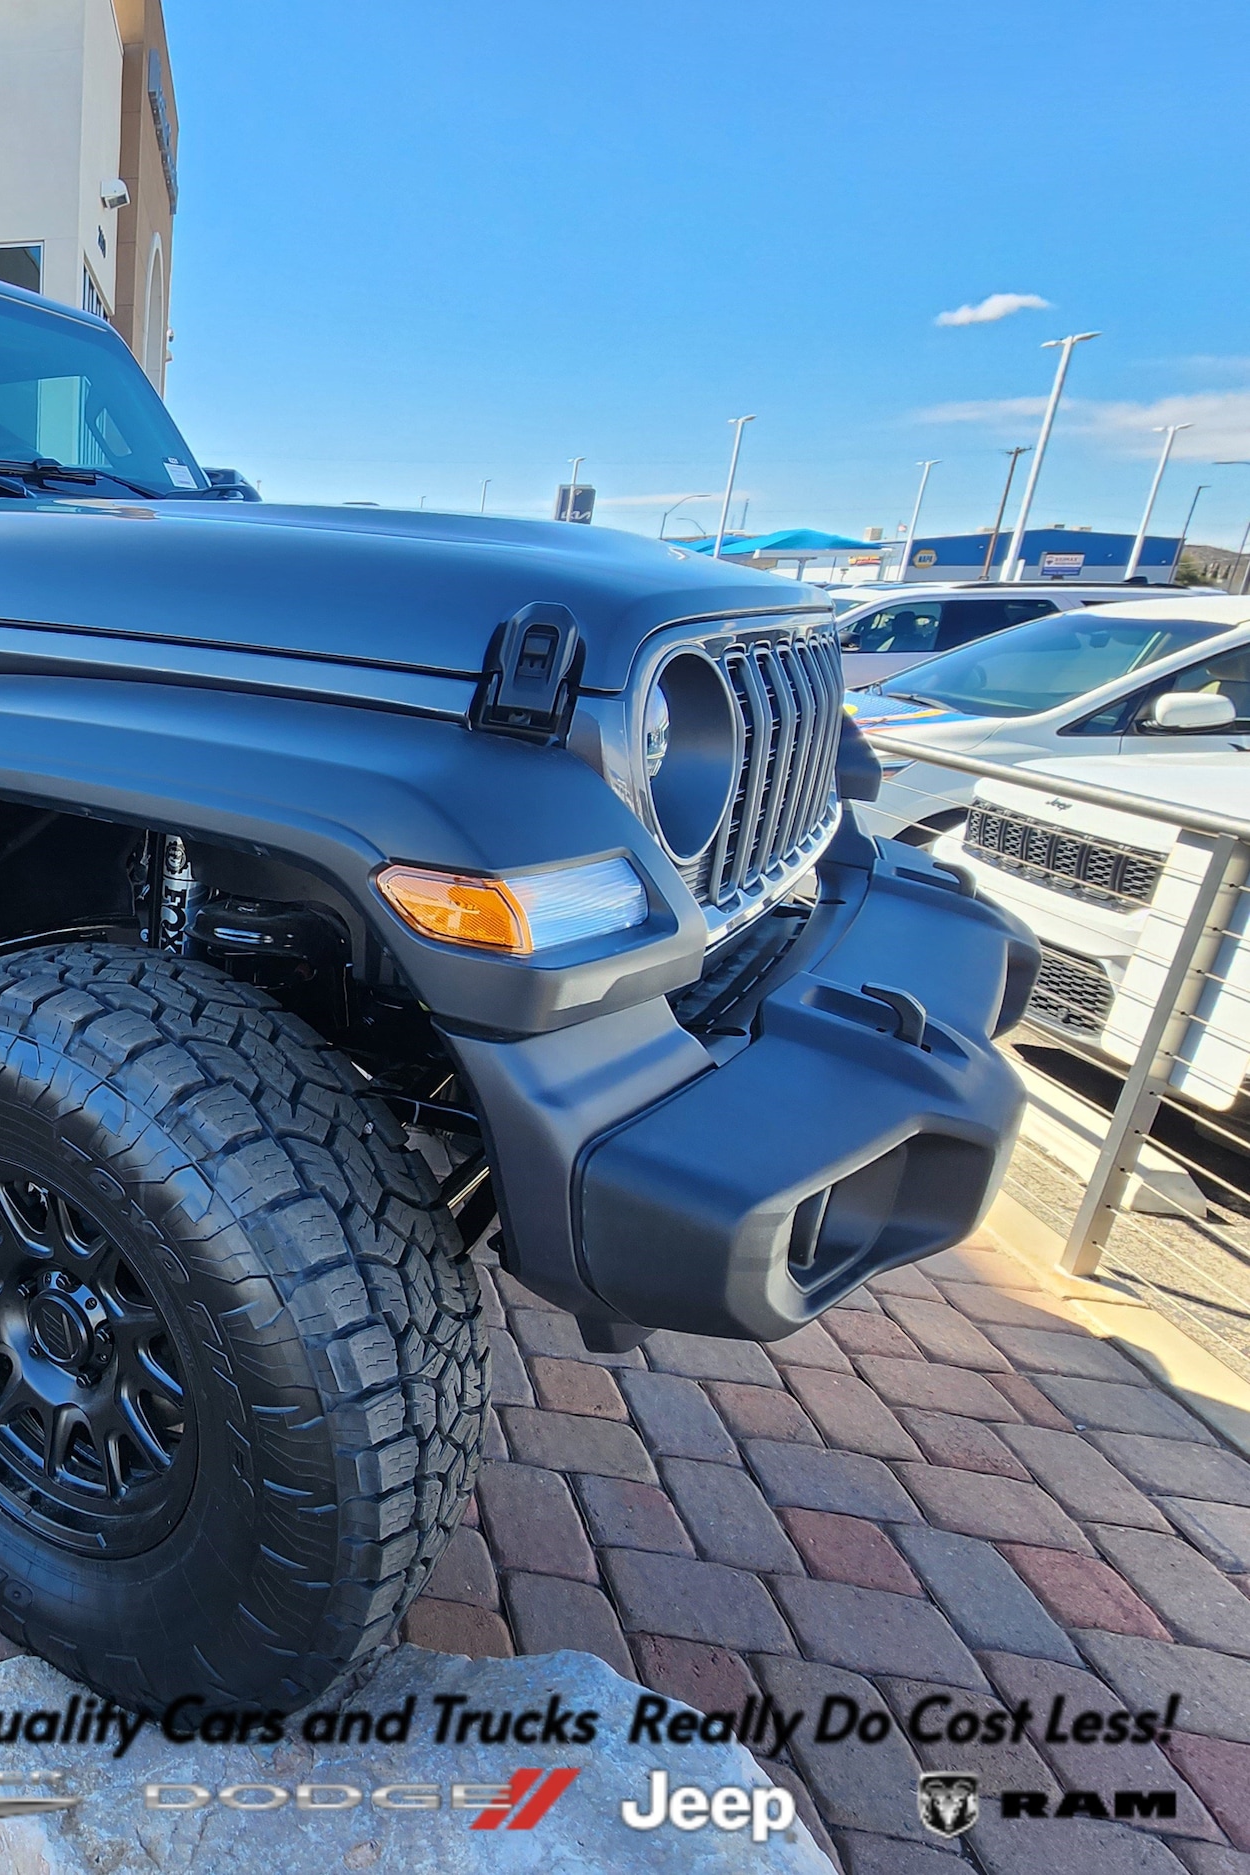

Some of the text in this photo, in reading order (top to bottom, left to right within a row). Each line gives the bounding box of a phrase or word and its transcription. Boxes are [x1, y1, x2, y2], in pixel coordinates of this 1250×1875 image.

[1045, 797, 1073, 811] Jeep
[161, 885, 187, 954] FOX
[54, 1136, 191, 1284] TOYO
